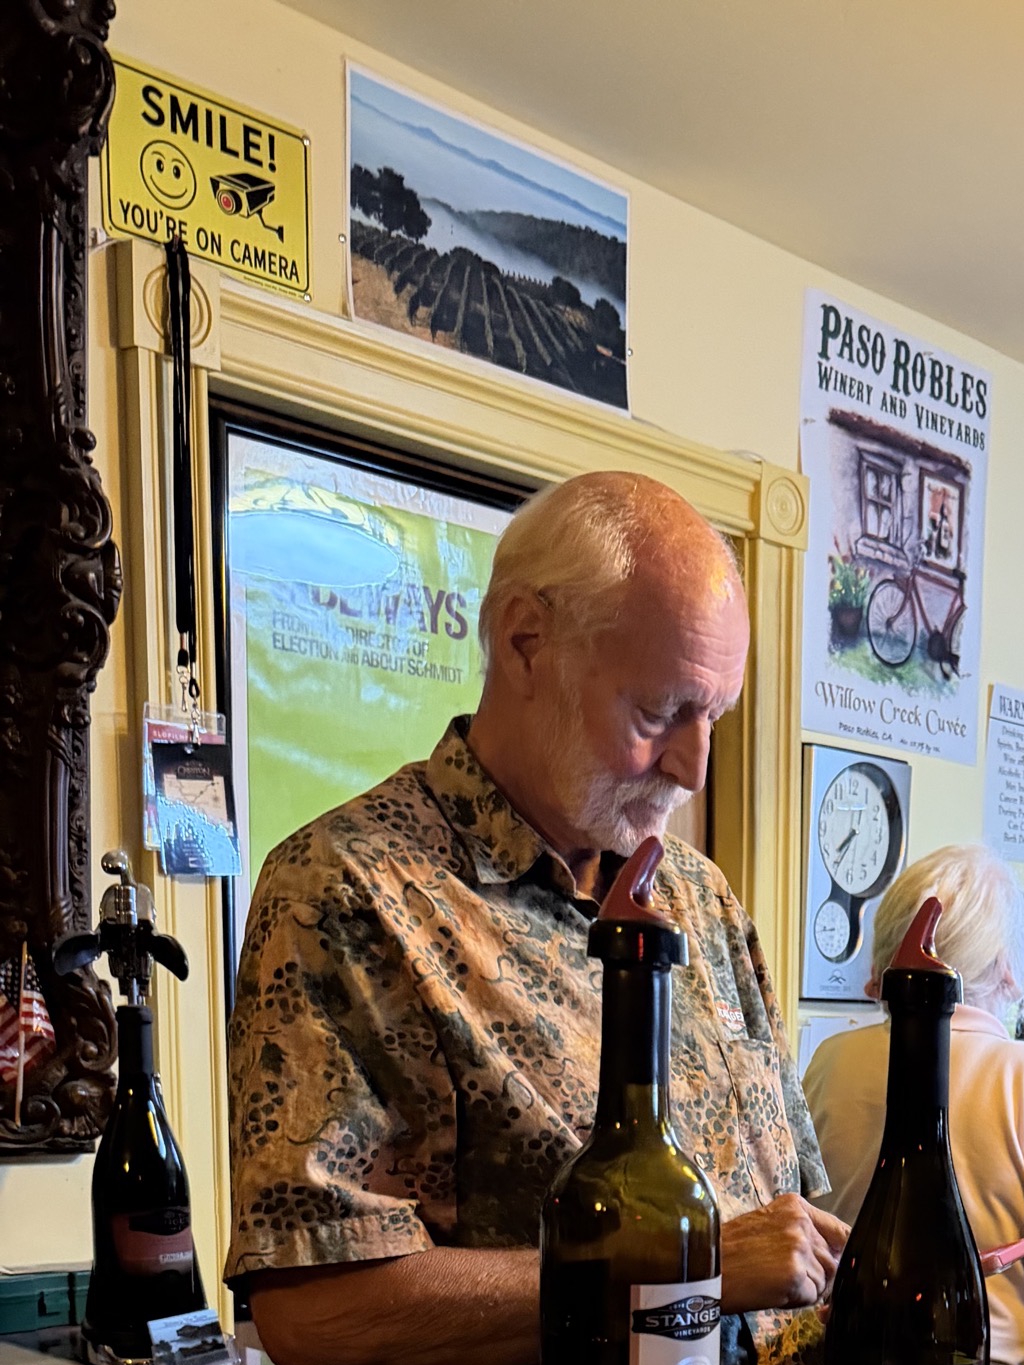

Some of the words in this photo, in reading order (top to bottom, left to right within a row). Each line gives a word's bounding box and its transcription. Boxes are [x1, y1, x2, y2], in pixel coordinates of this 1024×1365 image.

[141, 84, 277, 173] SMILE!
[119, 198, 189, 246] YOU'RE
[196, 226, 222, 257] ON
[230, 239, 300, 284] CAMERA
[818, 303, 886, 376] PASO
[890, 338, 987, 420] ROBLES
[817, 360, 873, 406] WINERY
[880, 391, 907, 420] AND
[914, 402, 986, 451] VINEYARDS
[361, 650, 407, 672] ABOUT
[407, 659, 463, 684] SCHMIDT
[814, 681, 876, 715] Willow
[879, 697, 922, 727] Creek
[644, 1306, 720, 1328] STANGER
